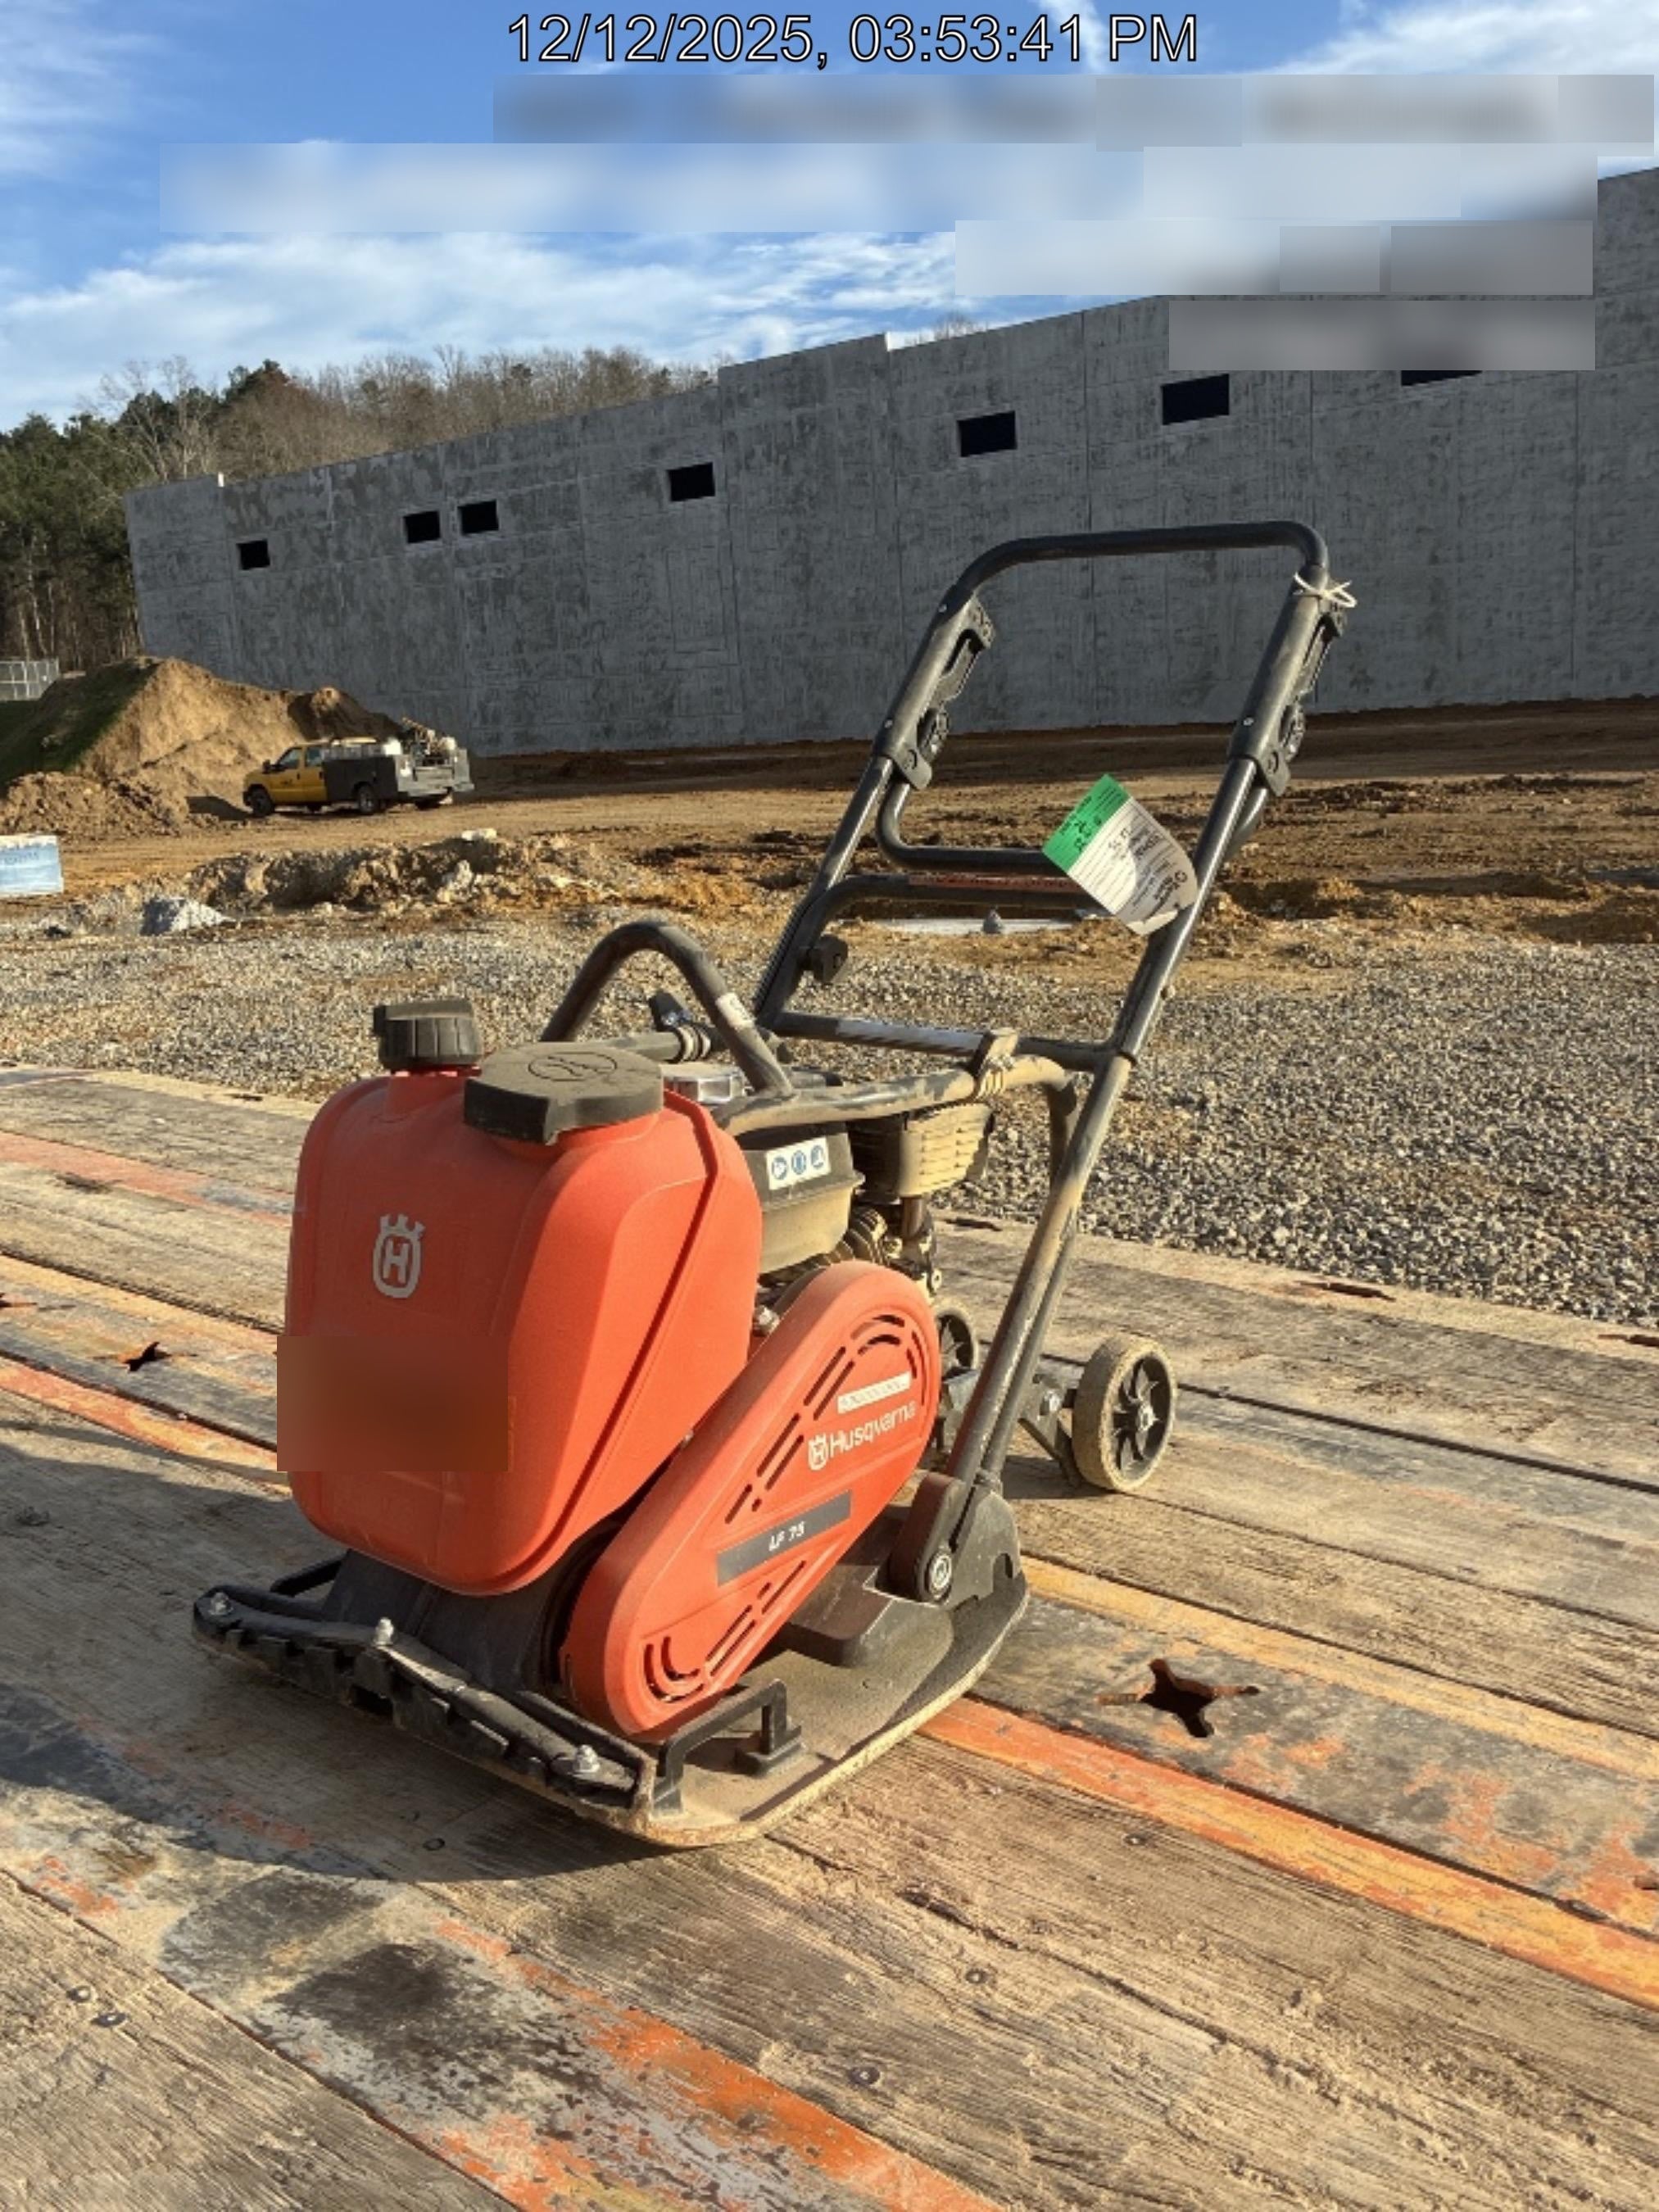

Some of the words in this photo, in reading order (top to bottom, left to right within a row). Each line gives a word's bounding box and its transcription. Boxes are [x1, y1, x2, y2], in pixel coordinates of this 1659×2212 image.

[829, 1401, 916, 1458] Husqvarna
[768, 1530, 785, 1552] LF
[788, 1521, 805, 1542] 75
